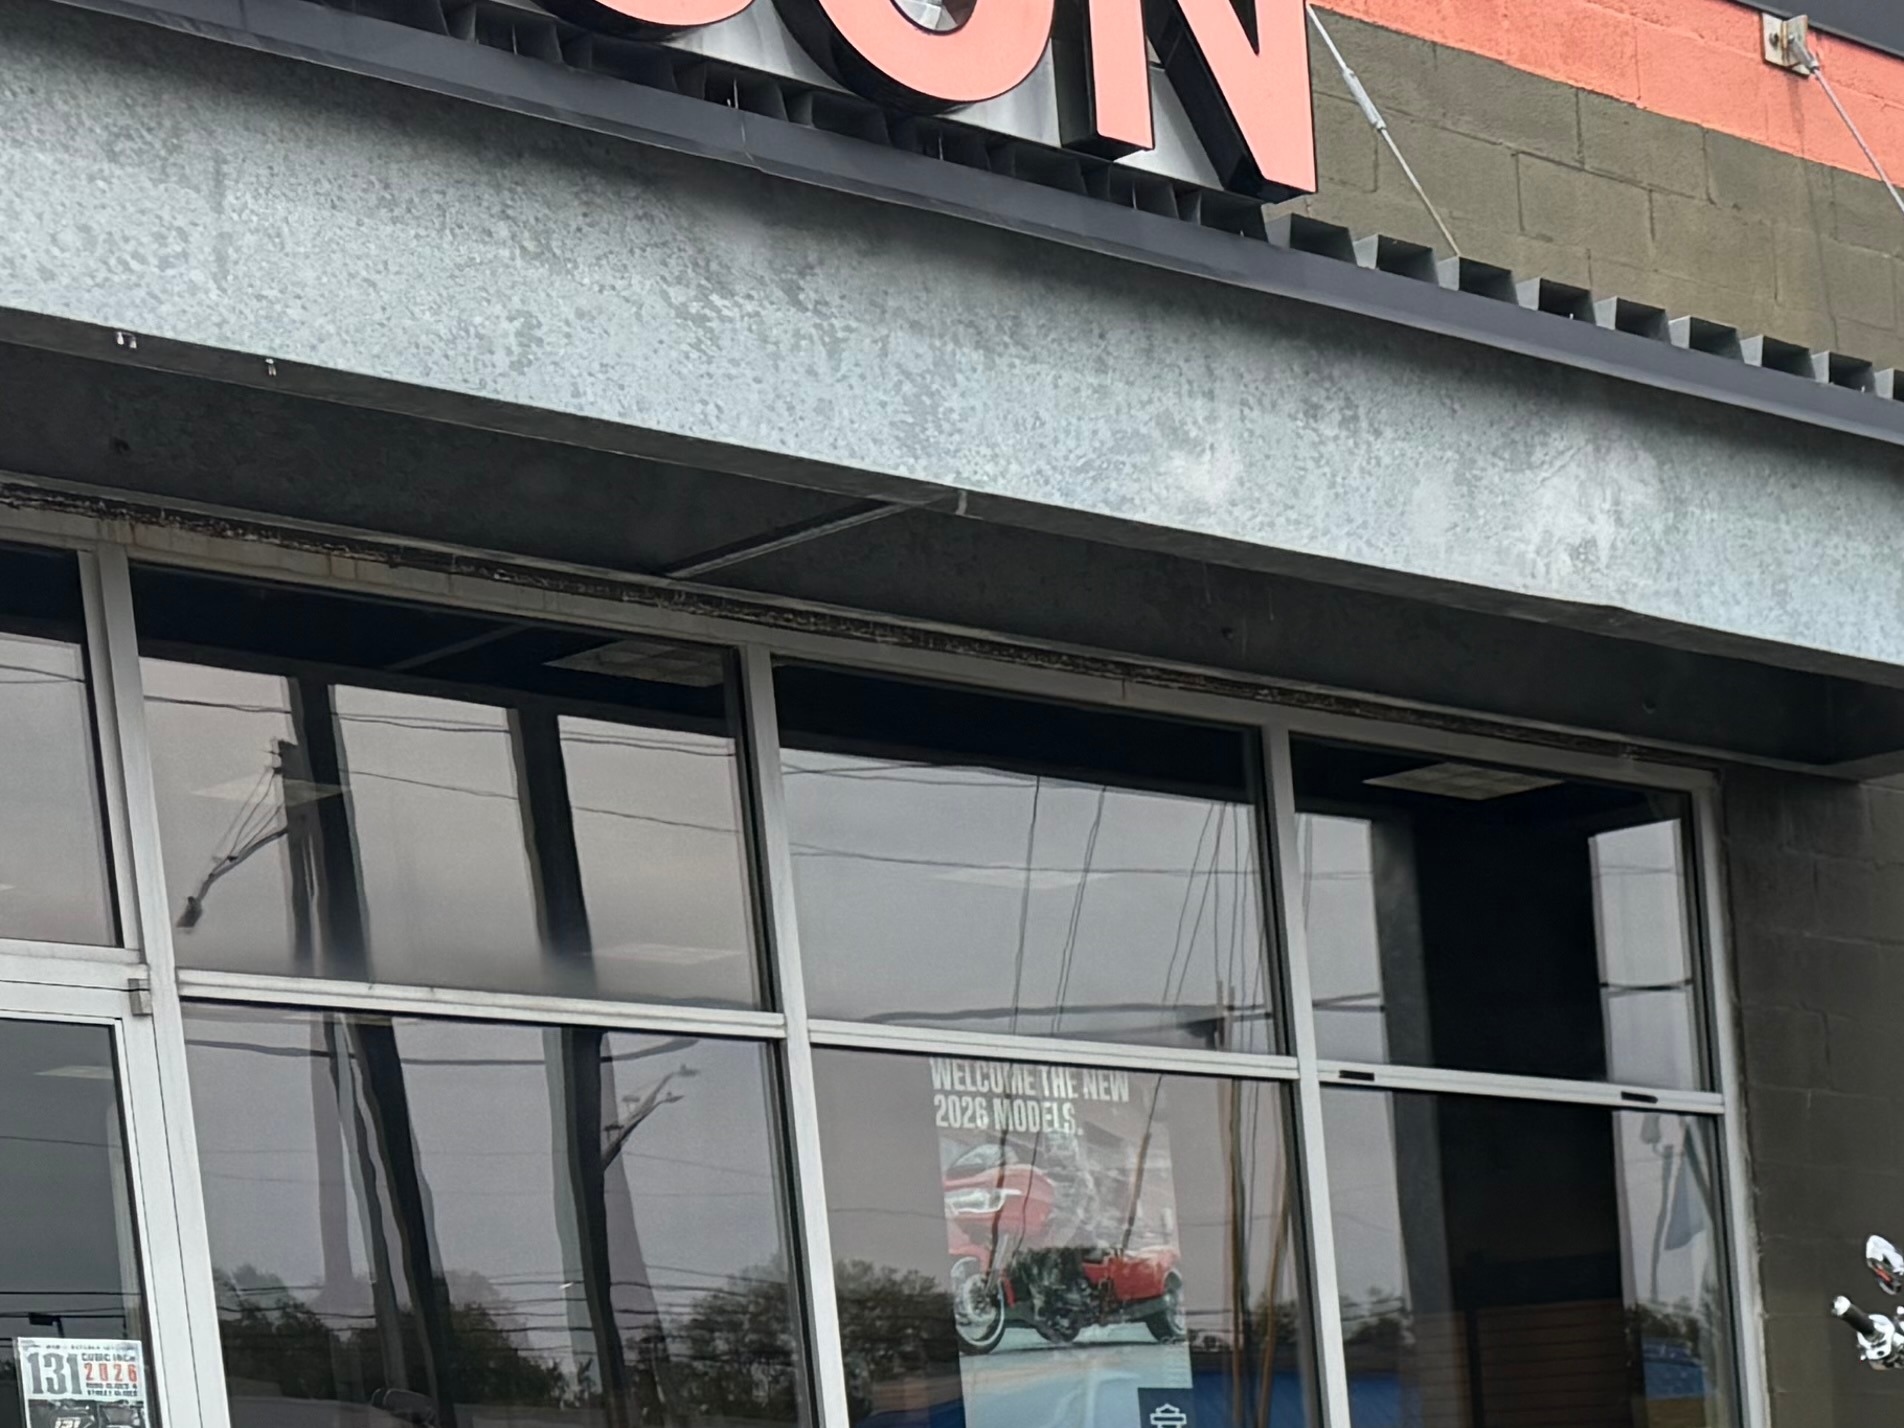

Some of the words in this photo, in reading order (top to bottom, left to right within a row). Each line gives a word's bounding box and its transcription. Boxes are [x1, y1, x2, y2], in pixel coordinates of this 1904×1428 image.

[930, 1057, 1038, 1097] WELCOME
[1039, 1064, 1079, 1099] THE
[1082, 1068, 1130, 1103] NEW
[934, 1095, 990, 1130] 2026
[993, 1099, 1084, 1136] MODELS.
[27, 1351, 83, 1395] 131
[83, 1362, 139, 1383] 2026
